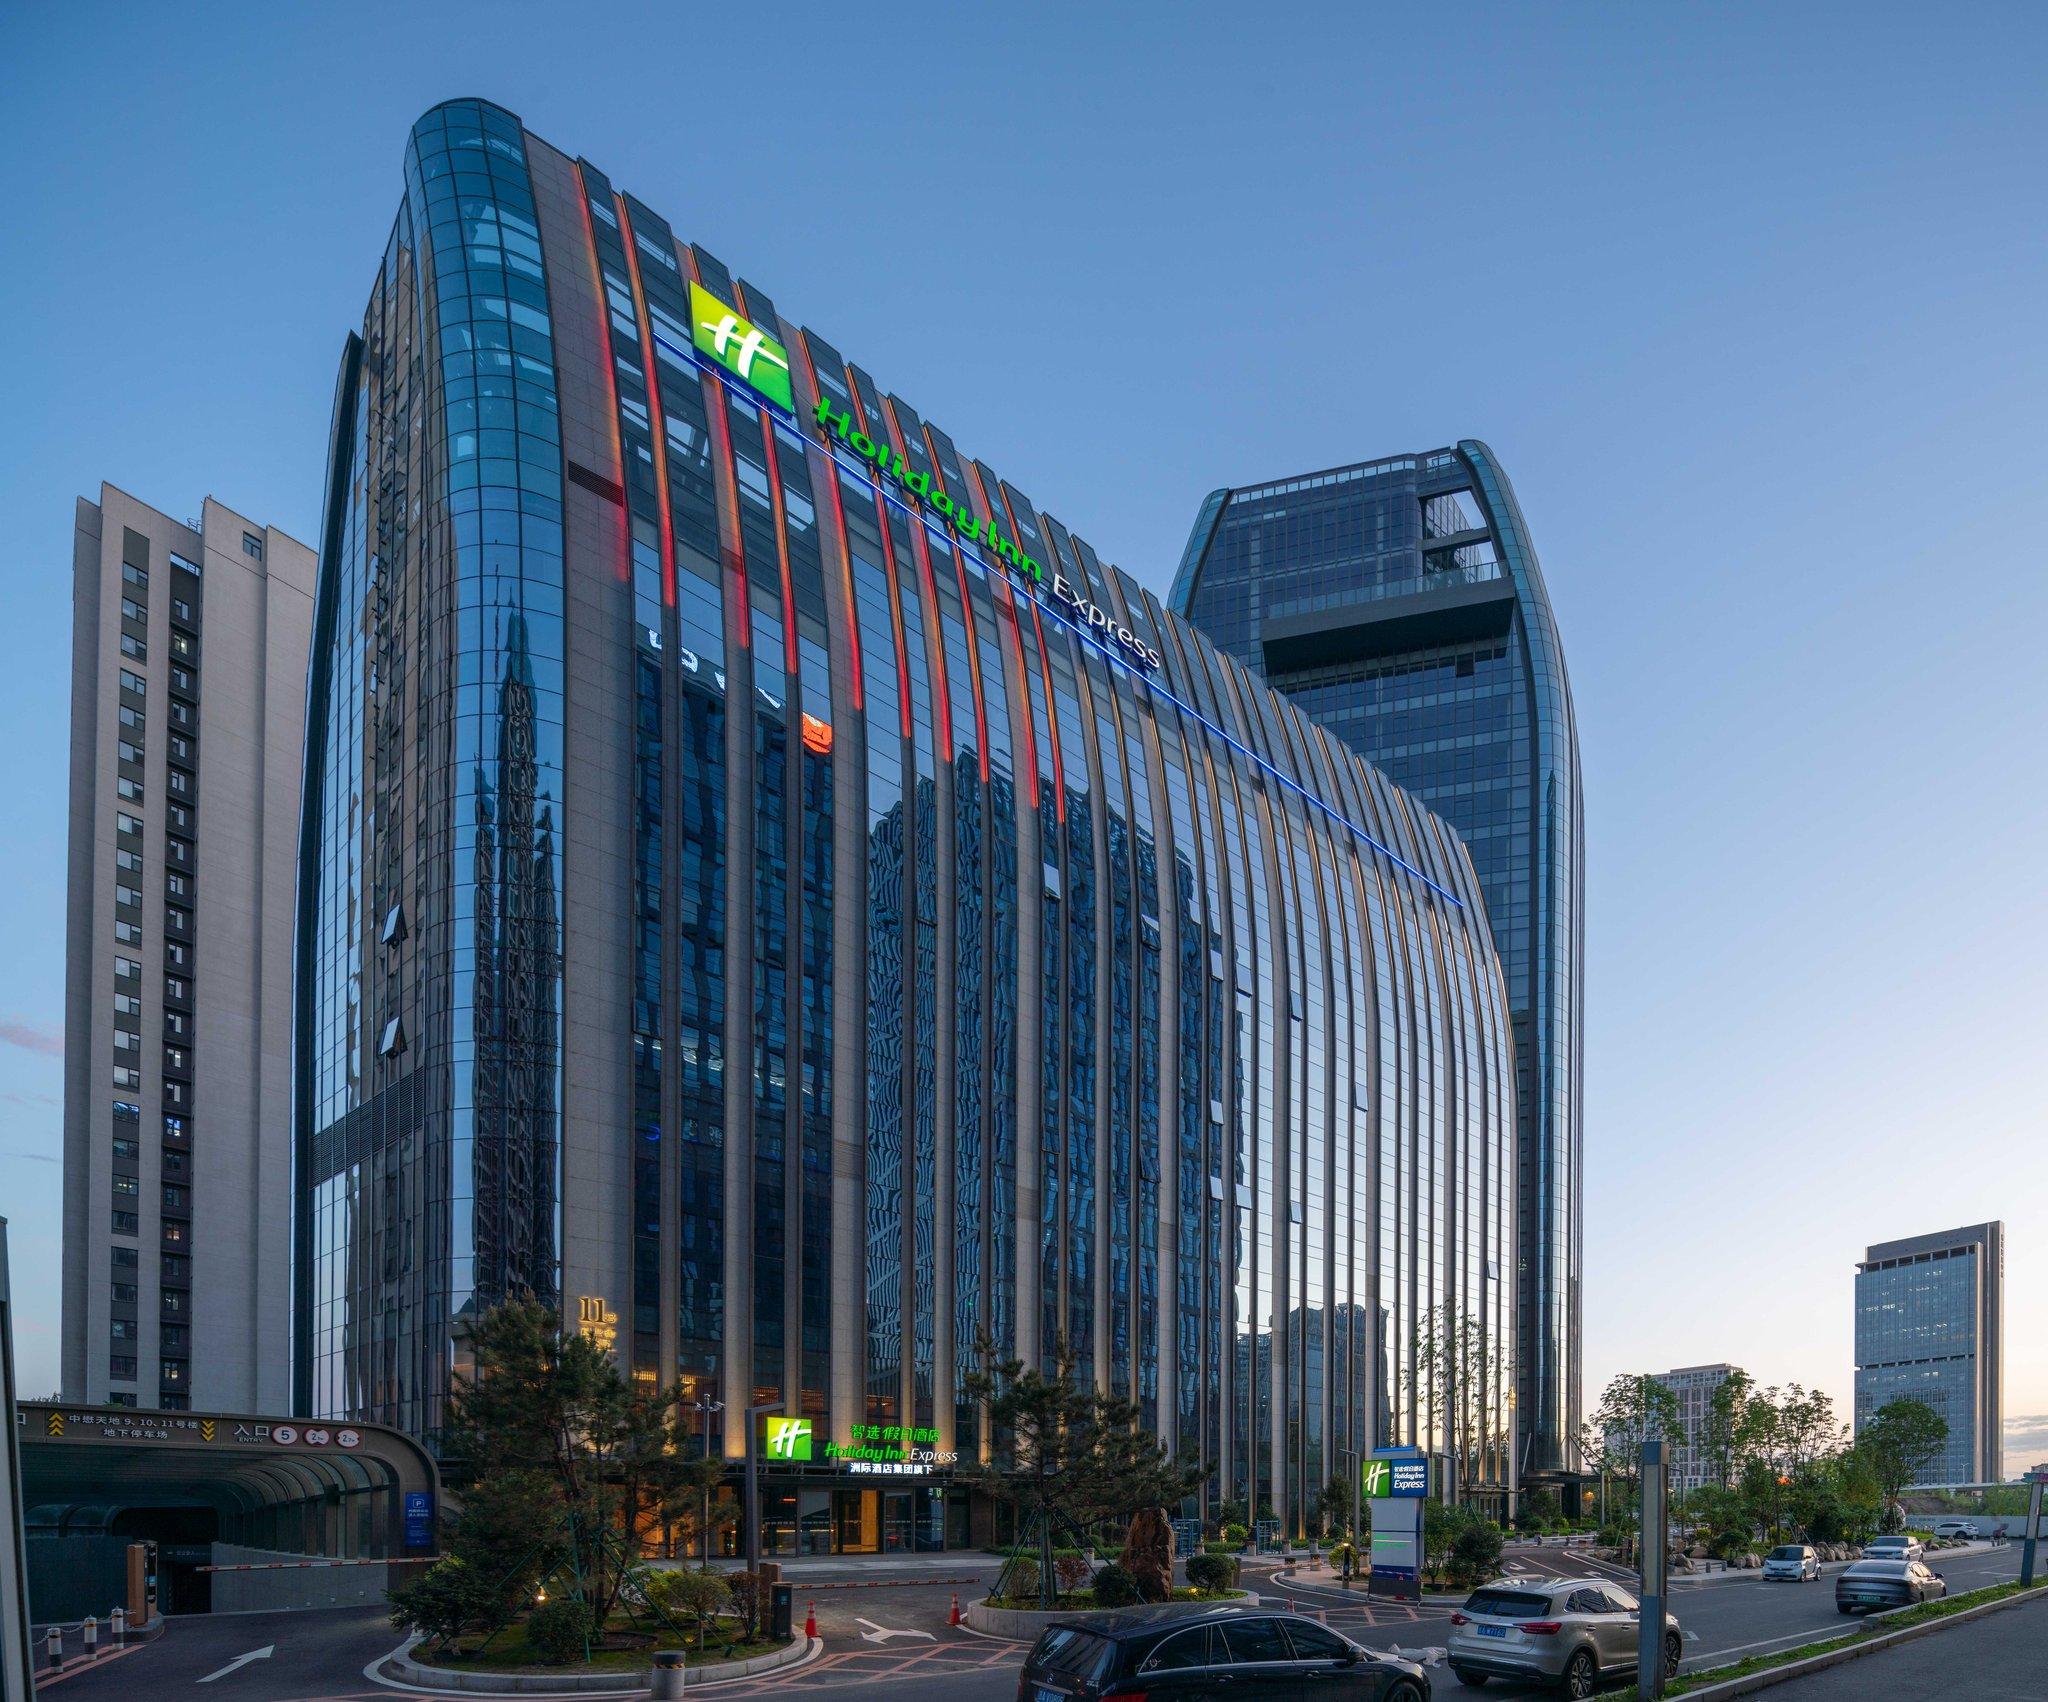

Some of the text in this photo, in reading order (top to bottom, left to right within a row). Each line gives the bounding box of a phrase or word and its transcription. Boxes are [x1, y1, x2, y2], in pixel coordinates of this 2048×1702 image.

[813, 395, 1161, 669] Holiday Inn Express
[103, 1428, 168, 1440] 地下停车场
[234, 1424, 269, 1436] 入口
[281, 1430, 290, 1440] 5
[851, 1423, 942, 1442] 智选假日酒店
[824, 1442, 958, 1463] Holiday Inn Express
[850, 1462, 934, 1475] 洲际酒店集团旗下
[1394, 1472, 1414, 1480] Holiday
[1394, 1480, 1425, 1491] Express
